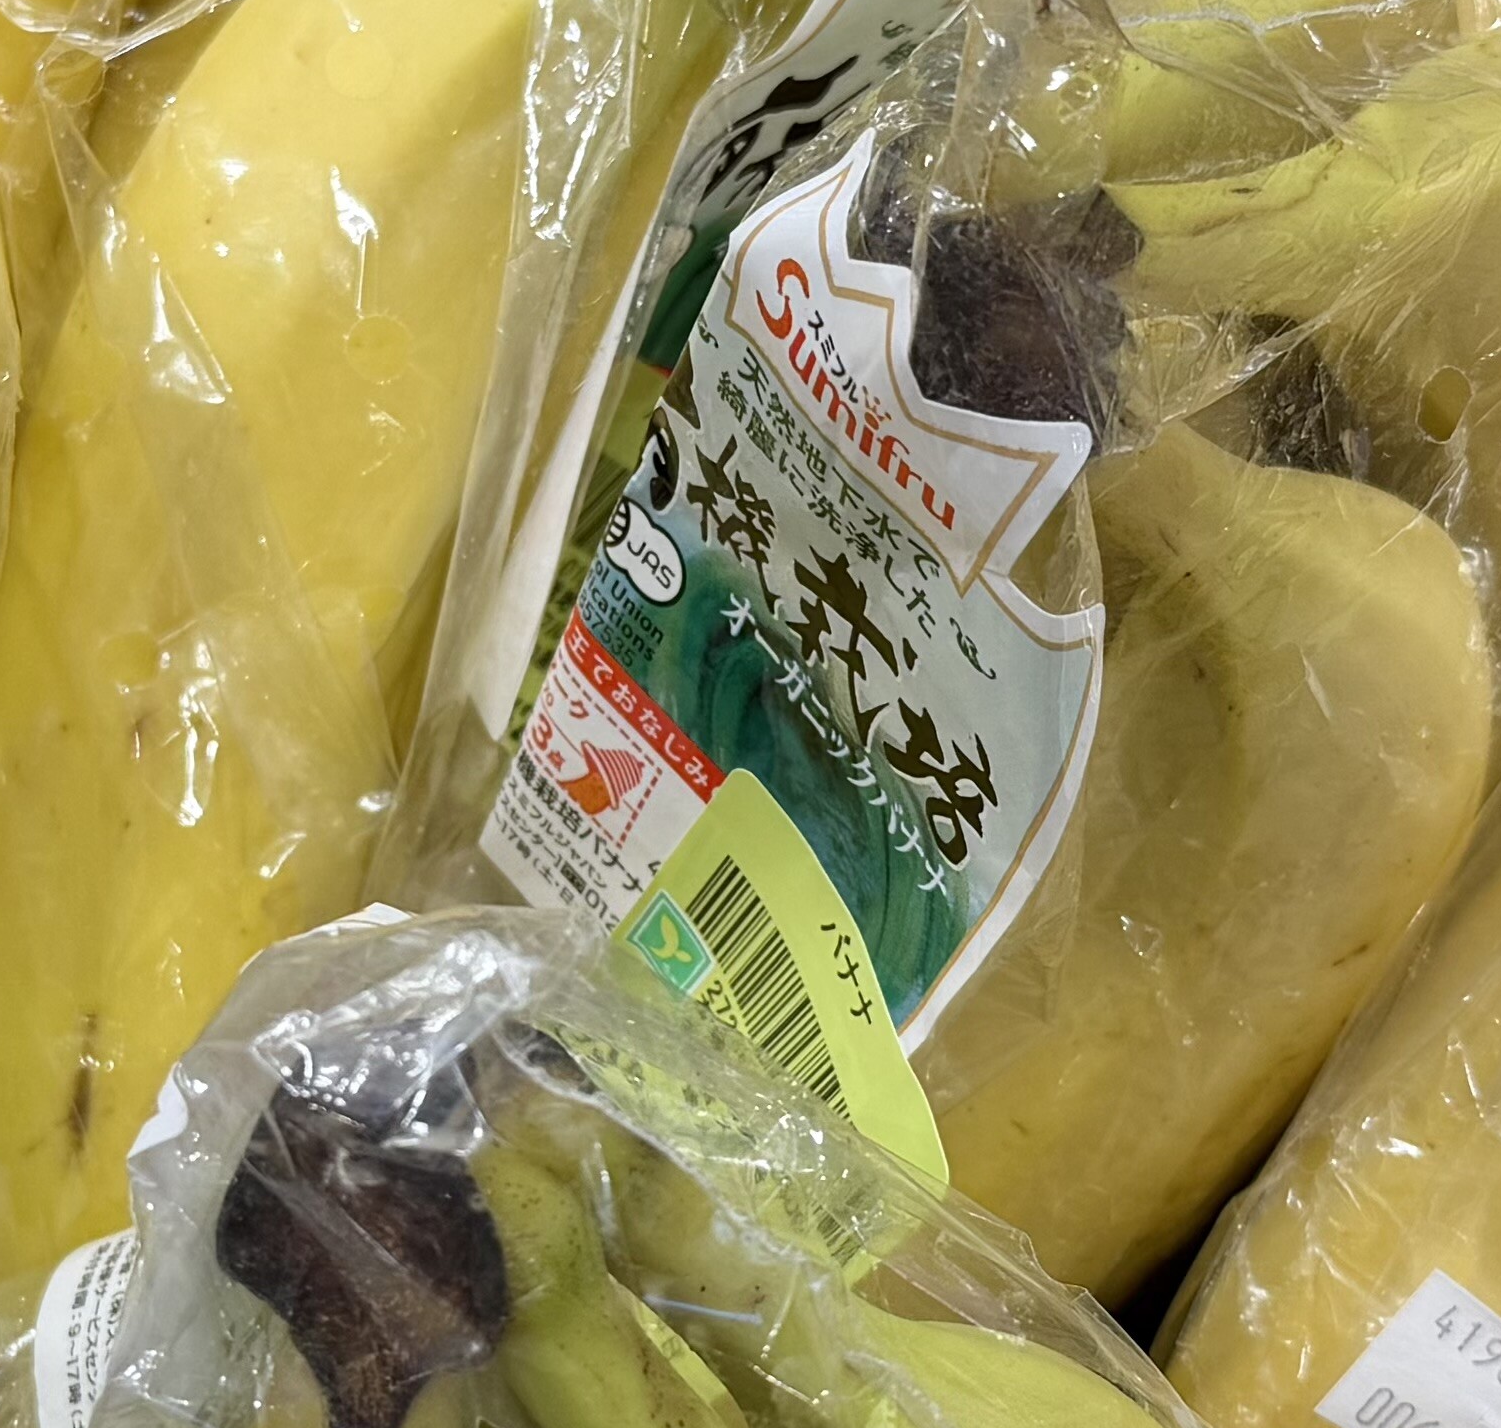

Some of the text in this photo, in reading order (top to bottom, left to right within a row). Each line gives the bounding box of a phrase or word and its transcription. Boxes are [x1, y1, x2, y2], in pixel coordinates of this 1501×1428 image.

[756, 258, 956, 531] Sumifru
[806, 309, 859, 405] スミフル
[716, 370, 938, 639] 綺麗に洗浄した
[737, 346, 941, 580] 天然地下水で
[610, 578, 664, 645] Union
[626, 539, 676, 590] JAS
[719, 592, 952, 896] オーガニックバナナ
[820, 921, 873, 1026] バナナ
